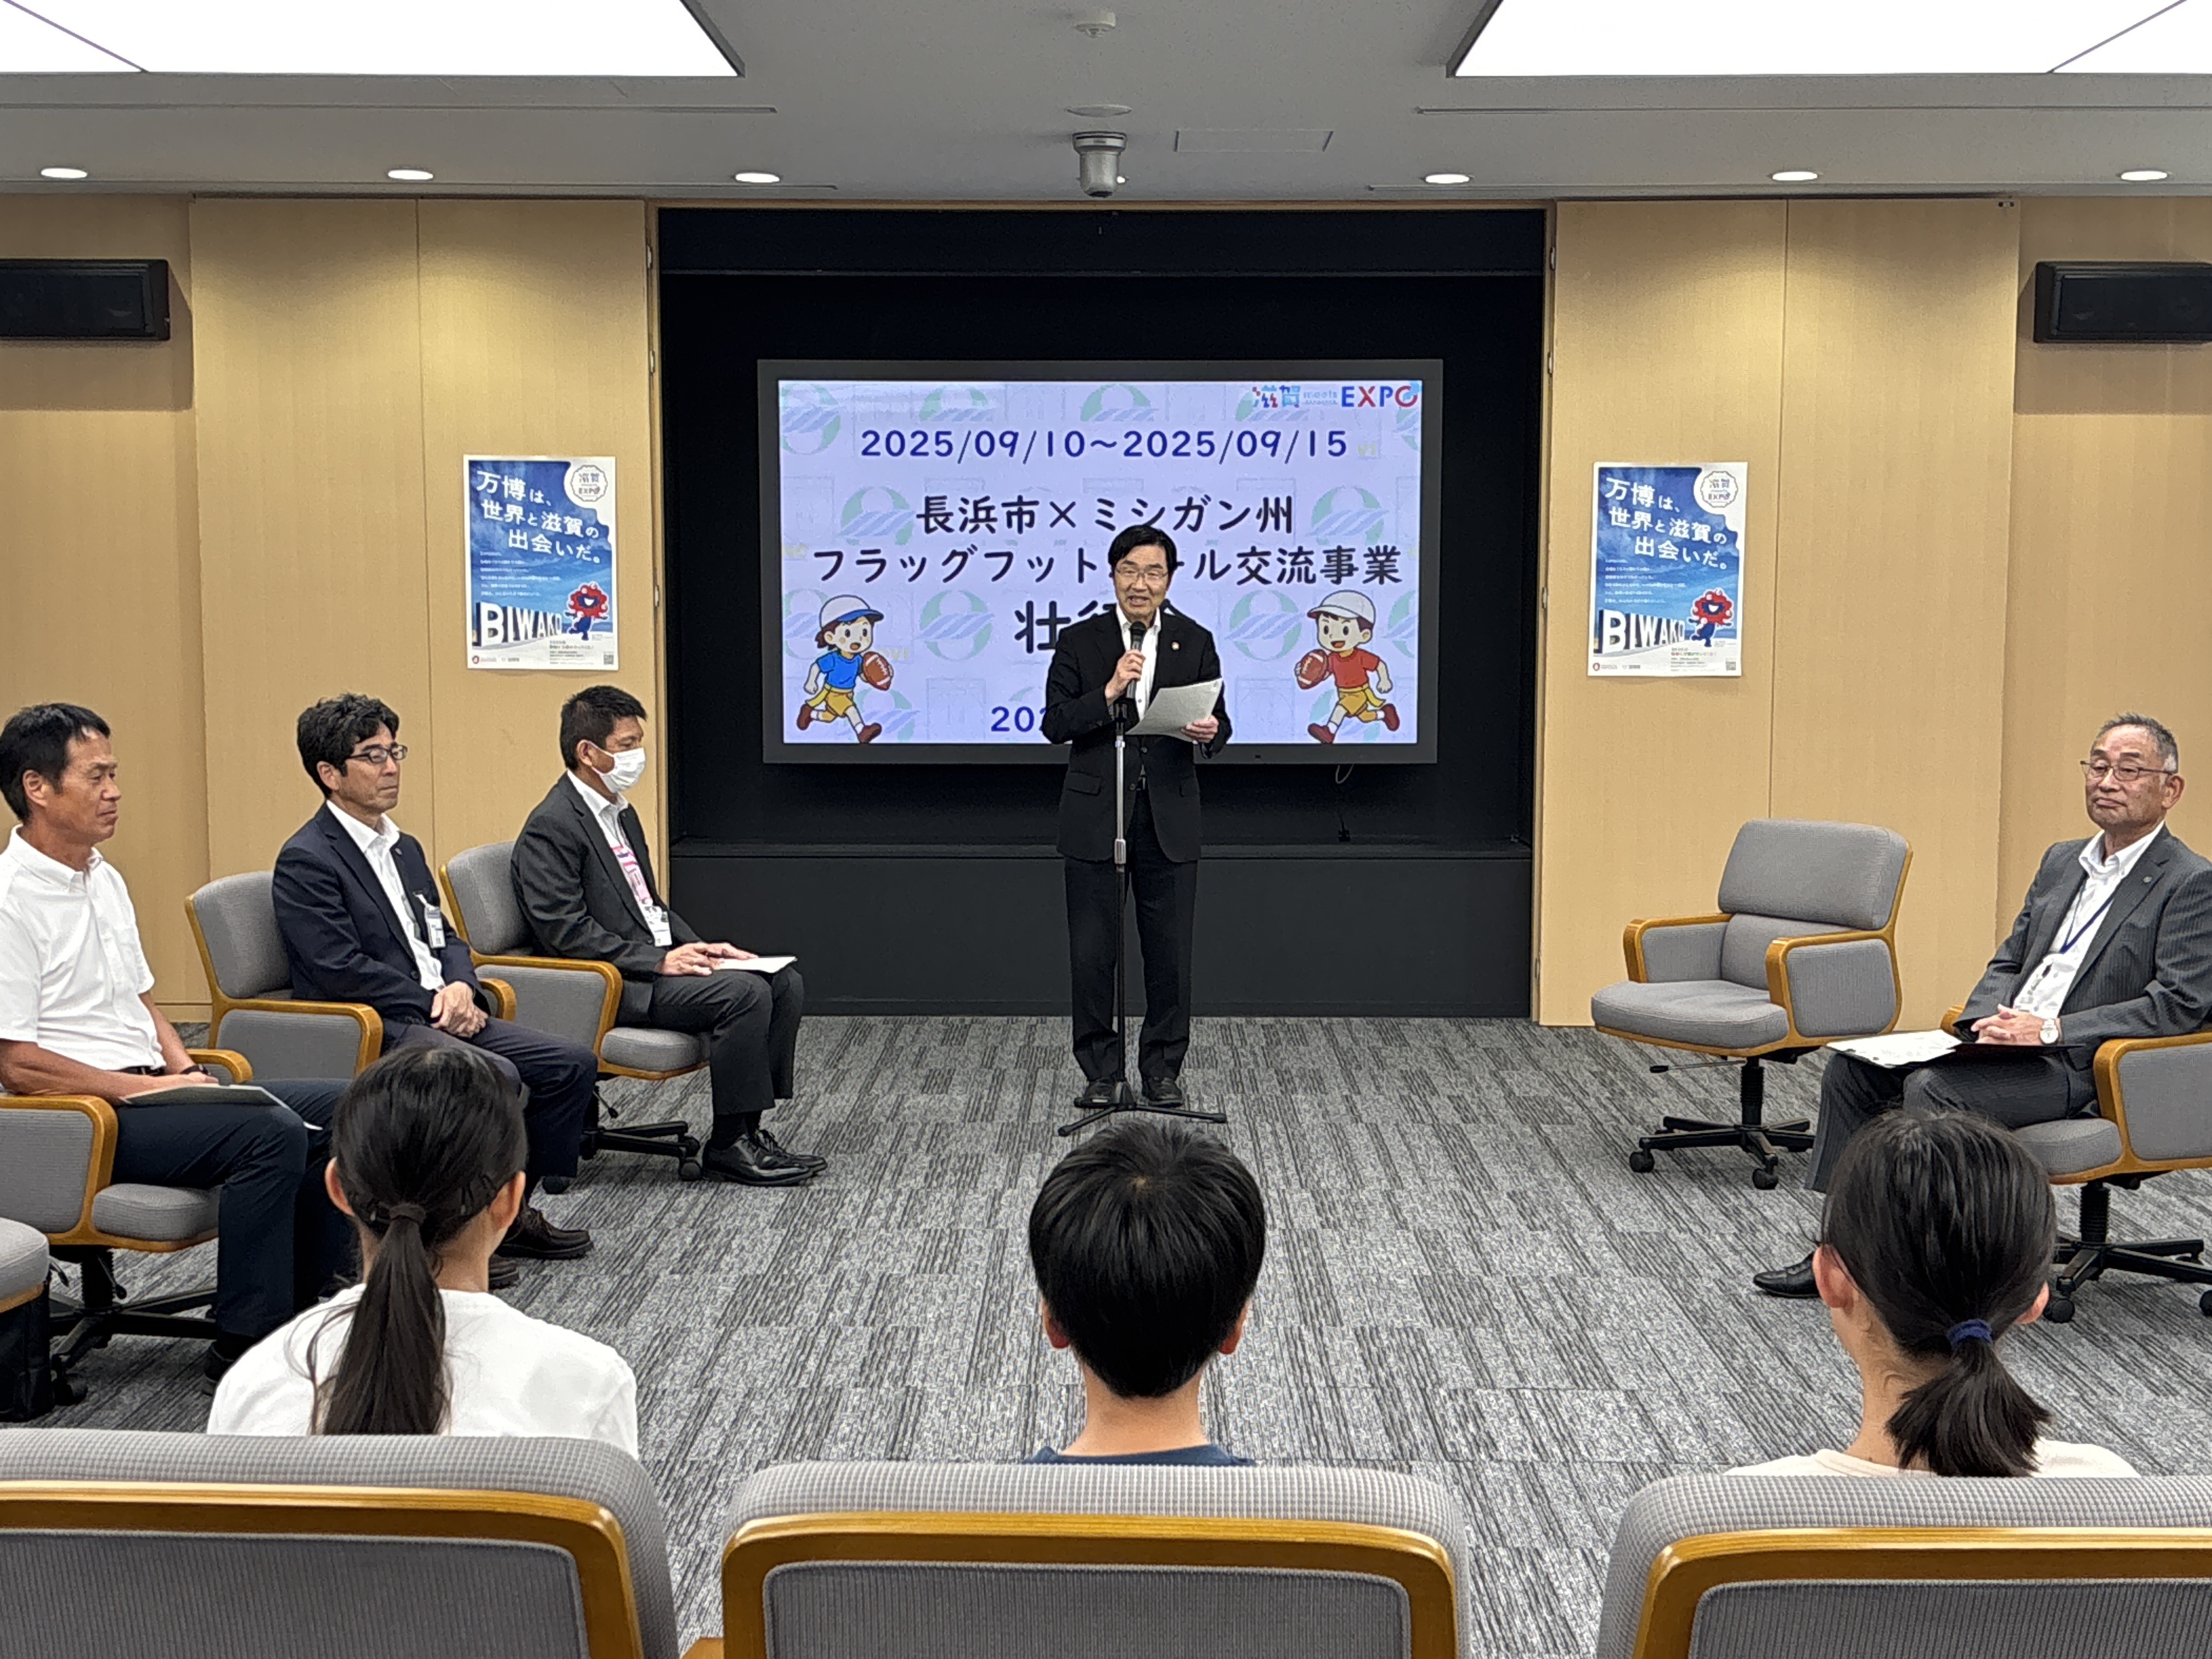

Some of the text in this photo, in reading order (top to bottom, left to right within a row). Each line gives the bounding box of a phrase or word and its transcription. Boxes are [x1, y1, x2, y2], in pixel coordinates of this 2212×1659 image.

[1341, 382, 1418, 407] EXPO
[476, 470, 552, 506] 万博は、
[1605, 477, 1680, 513] 万博は、
[481, 500, 599, 539] 世界と滋賀の
[916, 494, 1293, 534] 長浜市×ミシガン州
[1608, 506, 1728, 545] 世界と滋賀の
[508, 528, 601, 563] 出会いだ。
[1634, 536, 1728, 570] 出会いだ。
[814, 544, 1402, 585] フラッグフットル交流事業
[479, 601, 562, 648] BIWAKO
[1601, 609, 1685, 654] BIWAKO
[991, 706, 1046, 732] 20
